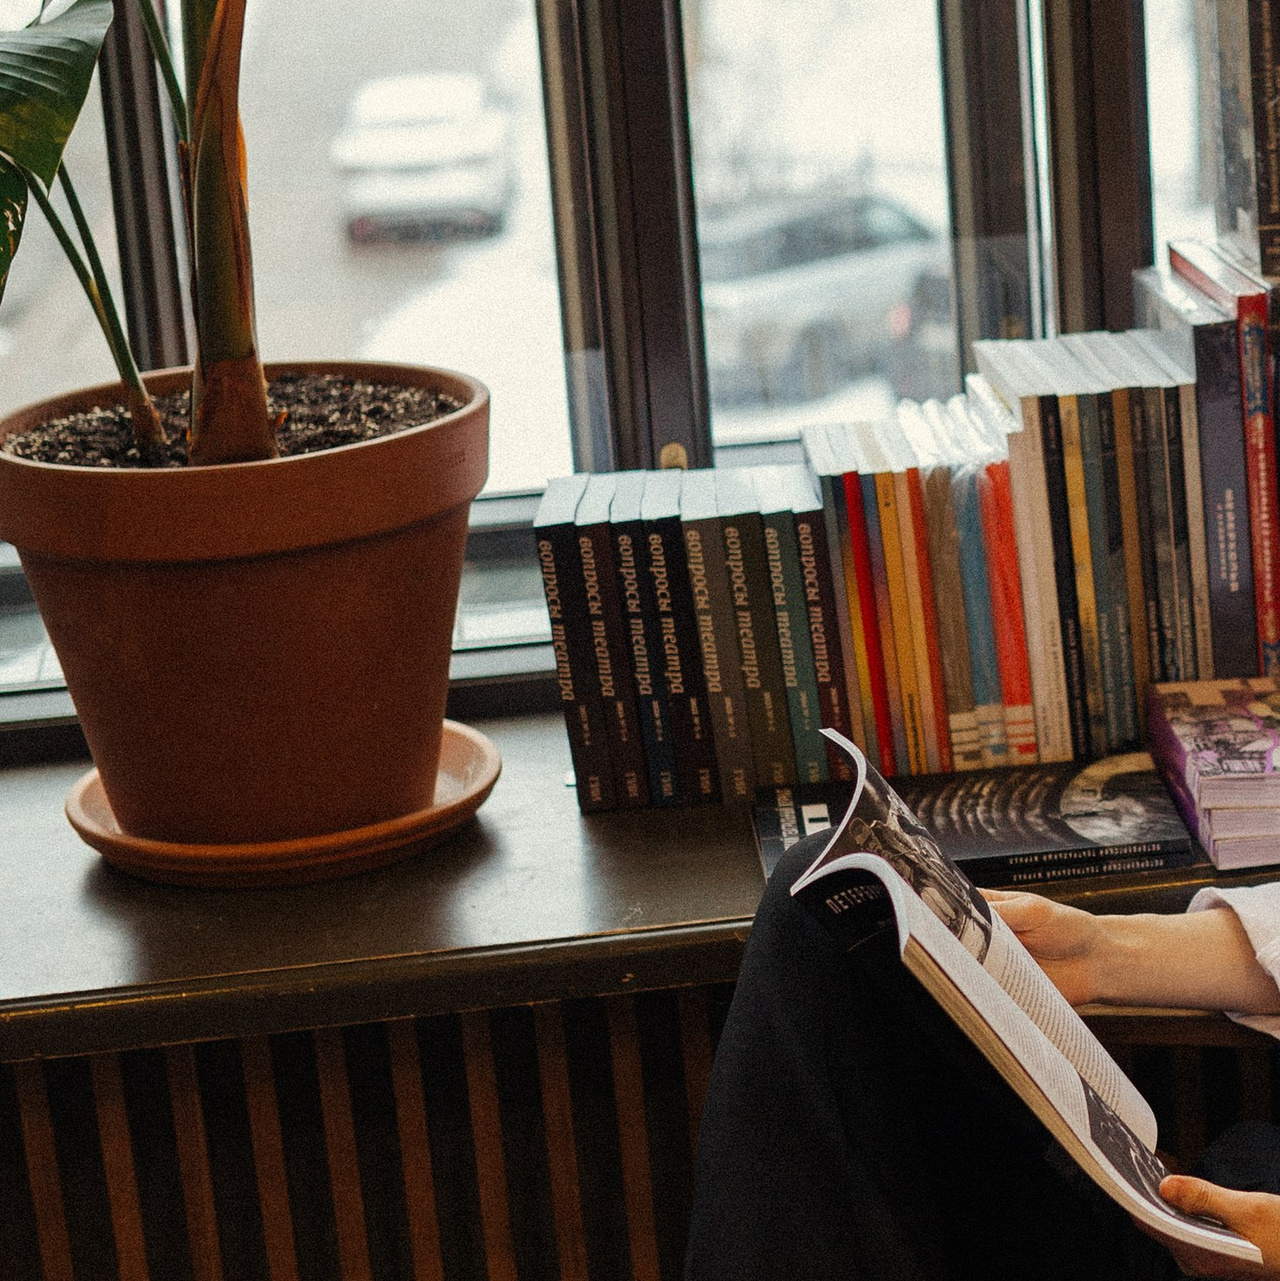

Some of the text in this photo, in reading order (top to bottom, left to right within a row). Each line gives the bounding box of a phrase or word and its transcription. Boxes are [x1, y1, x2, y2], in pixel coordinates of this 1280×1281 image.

[538, 540, 577, 701] вопросы театра
[578, 537, 617, 698] вопросы театра
[617, 534, 654, 696] вопросы театра
[648, 534, 685, 694] вопросы театра
[685, 530, 724, 693] вопросы театра
[724, 527, 762, 689] вопросы театра
[764, 527, 801, 687] вопросы театра
[797, 523, 833, 684] вопросы театра
[1042, 849, 1097, 864] ТЕАТРАЛЬНЫЙ
[1045, 864, 1099, 879] ТЕАТРАЛЬНЫЙ
